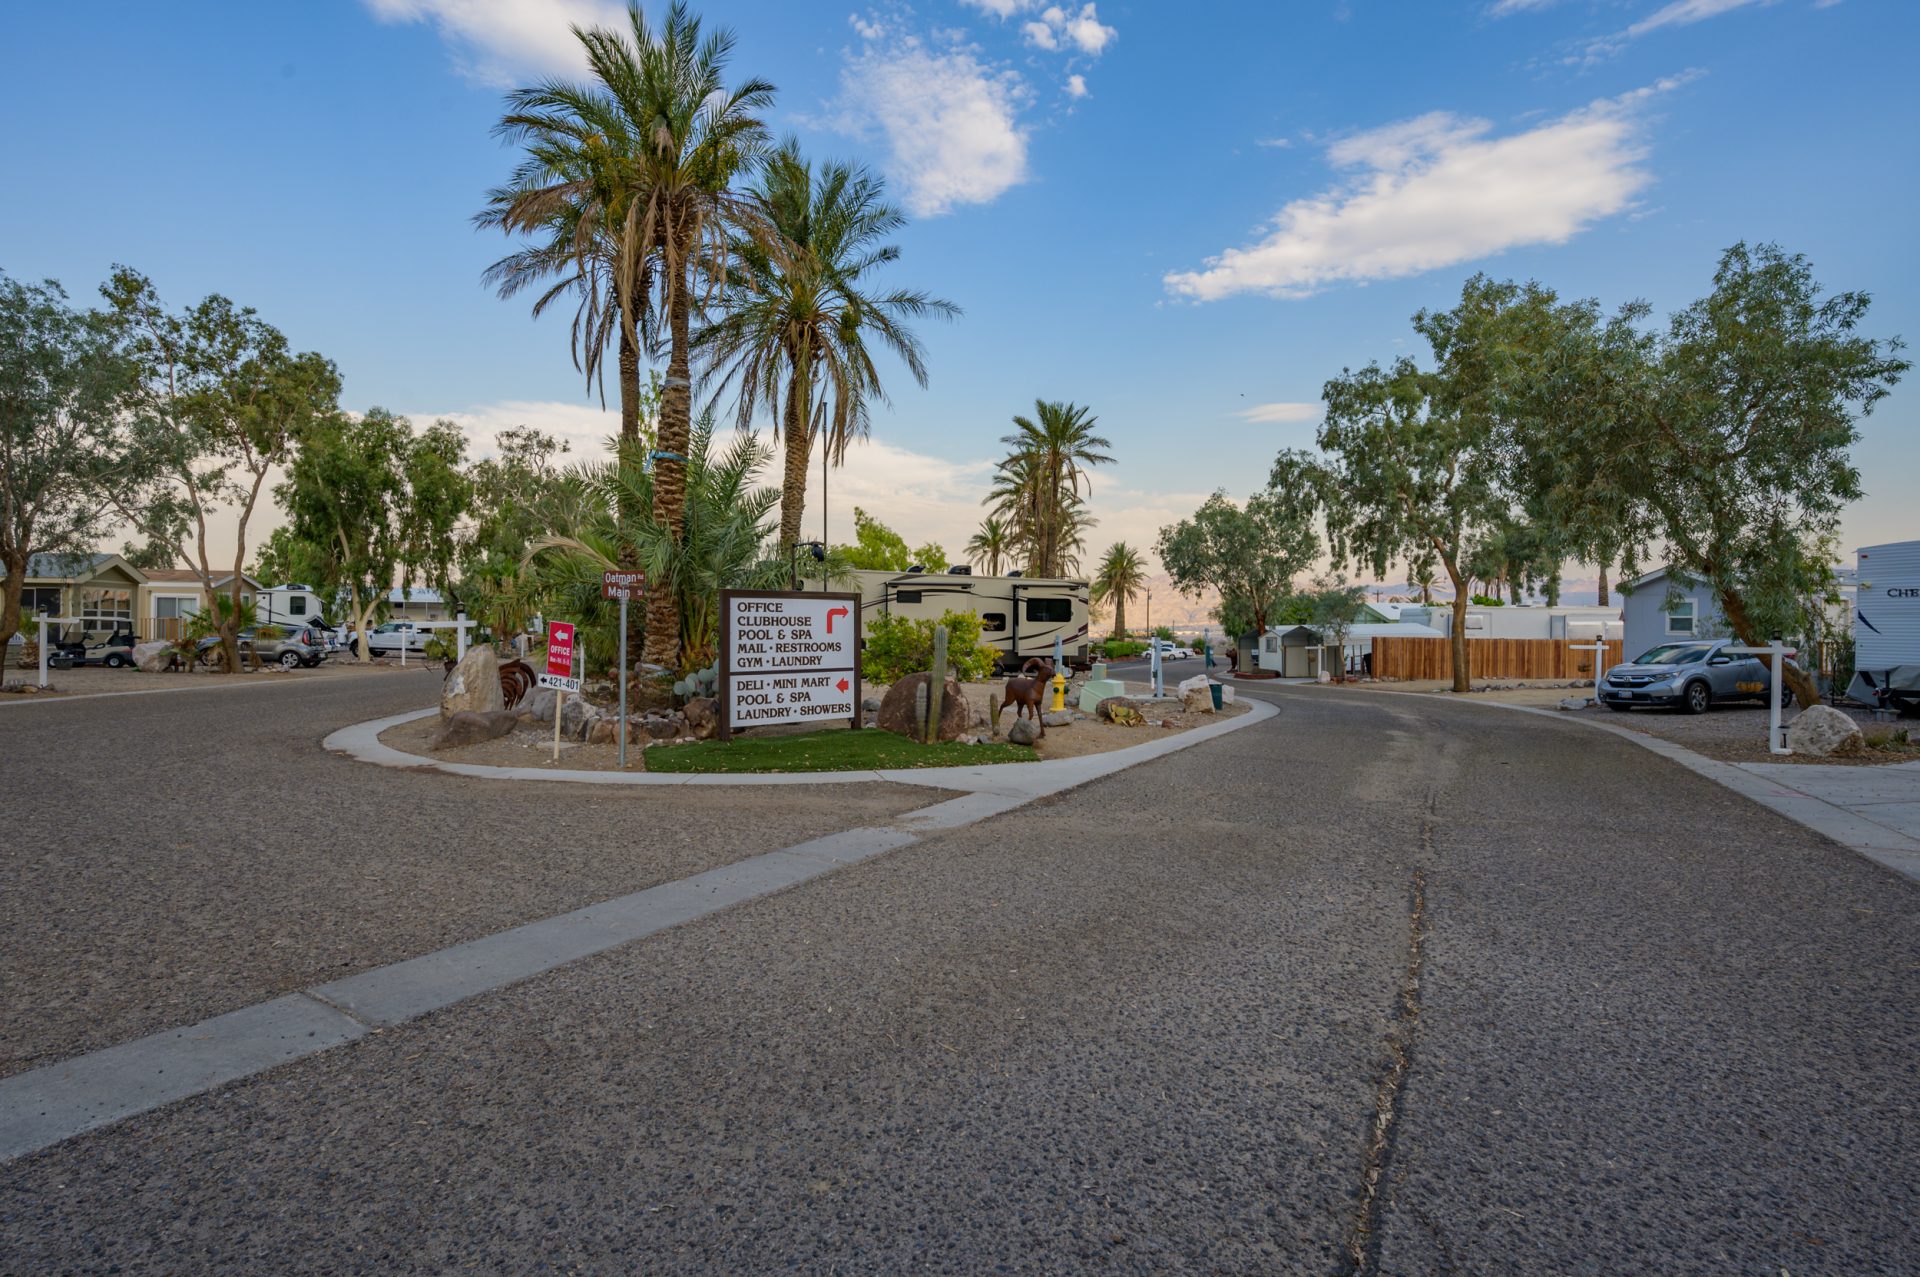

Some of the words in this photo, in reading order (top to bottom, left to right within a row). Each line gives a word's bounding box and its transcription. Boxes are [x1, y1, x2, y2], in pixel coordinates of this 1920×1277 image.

[605, 572, 637, 583] Oatman
[608, 586, 630, 598] Main
[737, 602, 783, 612] OFFICE
[737, 616, 811, 626] CLUBHOUSE
[738, 630, 773, 640] POOL
[778, 630, 786, 639] &
[791, 630, 812, 639] SPA
[550, 645, 571, 656] OFFICE
[737, 644, 767, 653] MAIL
[776, 642, 841, 652] RESTROOMS
[737, 658, 762, 667] GYM
[772, 656, 822, 666] LAUNDRY
[548, 676, 579, 690] 421-401
[737, 680, 763, 691] DELI
[773, 679, 797, 689] MINI
[801, 677, 831, 687] MART
[737, 695, 772, 705] POOL
[777, 693, 784, 703] &
[790, 692, 811, 702] SPA
[737, 707, 792, 720] LAUNDRY
[800, 703, 851, 715] SHOWERS
